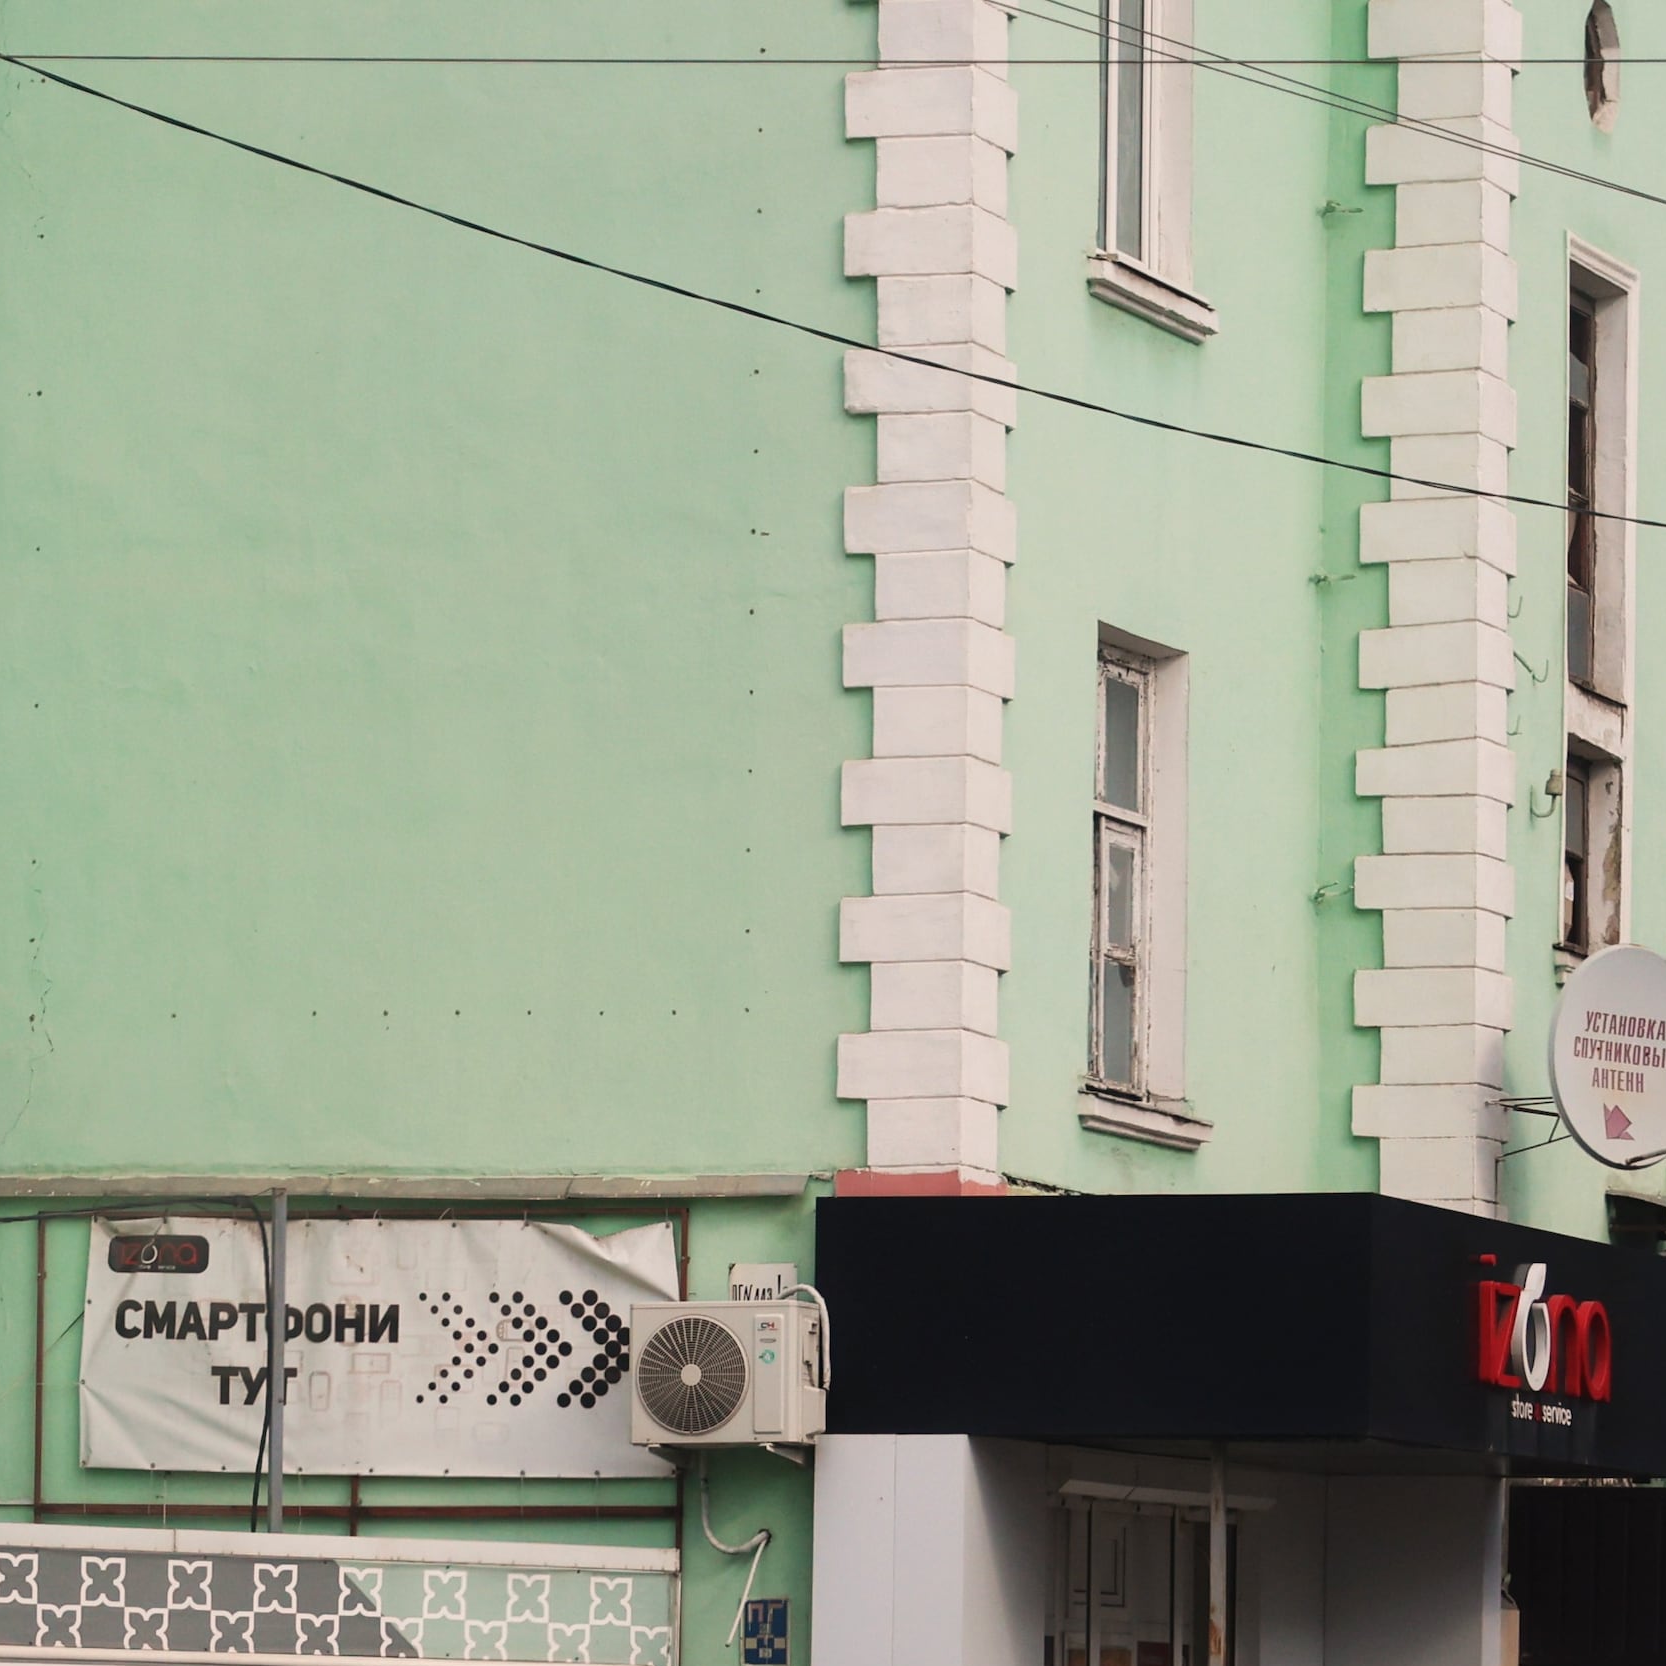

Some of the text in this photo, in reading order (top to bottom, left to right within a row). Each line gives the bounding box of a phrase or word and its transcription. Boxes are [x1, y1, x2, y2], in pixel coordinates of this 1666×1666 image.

[1585, 1011, 1666, 1040] УСТАНОВКА
[1592, 1067, 1644, 1093] АНТЕНН
[1511, 1393, 1533, 1421] store
[1541, 1402, 1572, 1427] service
